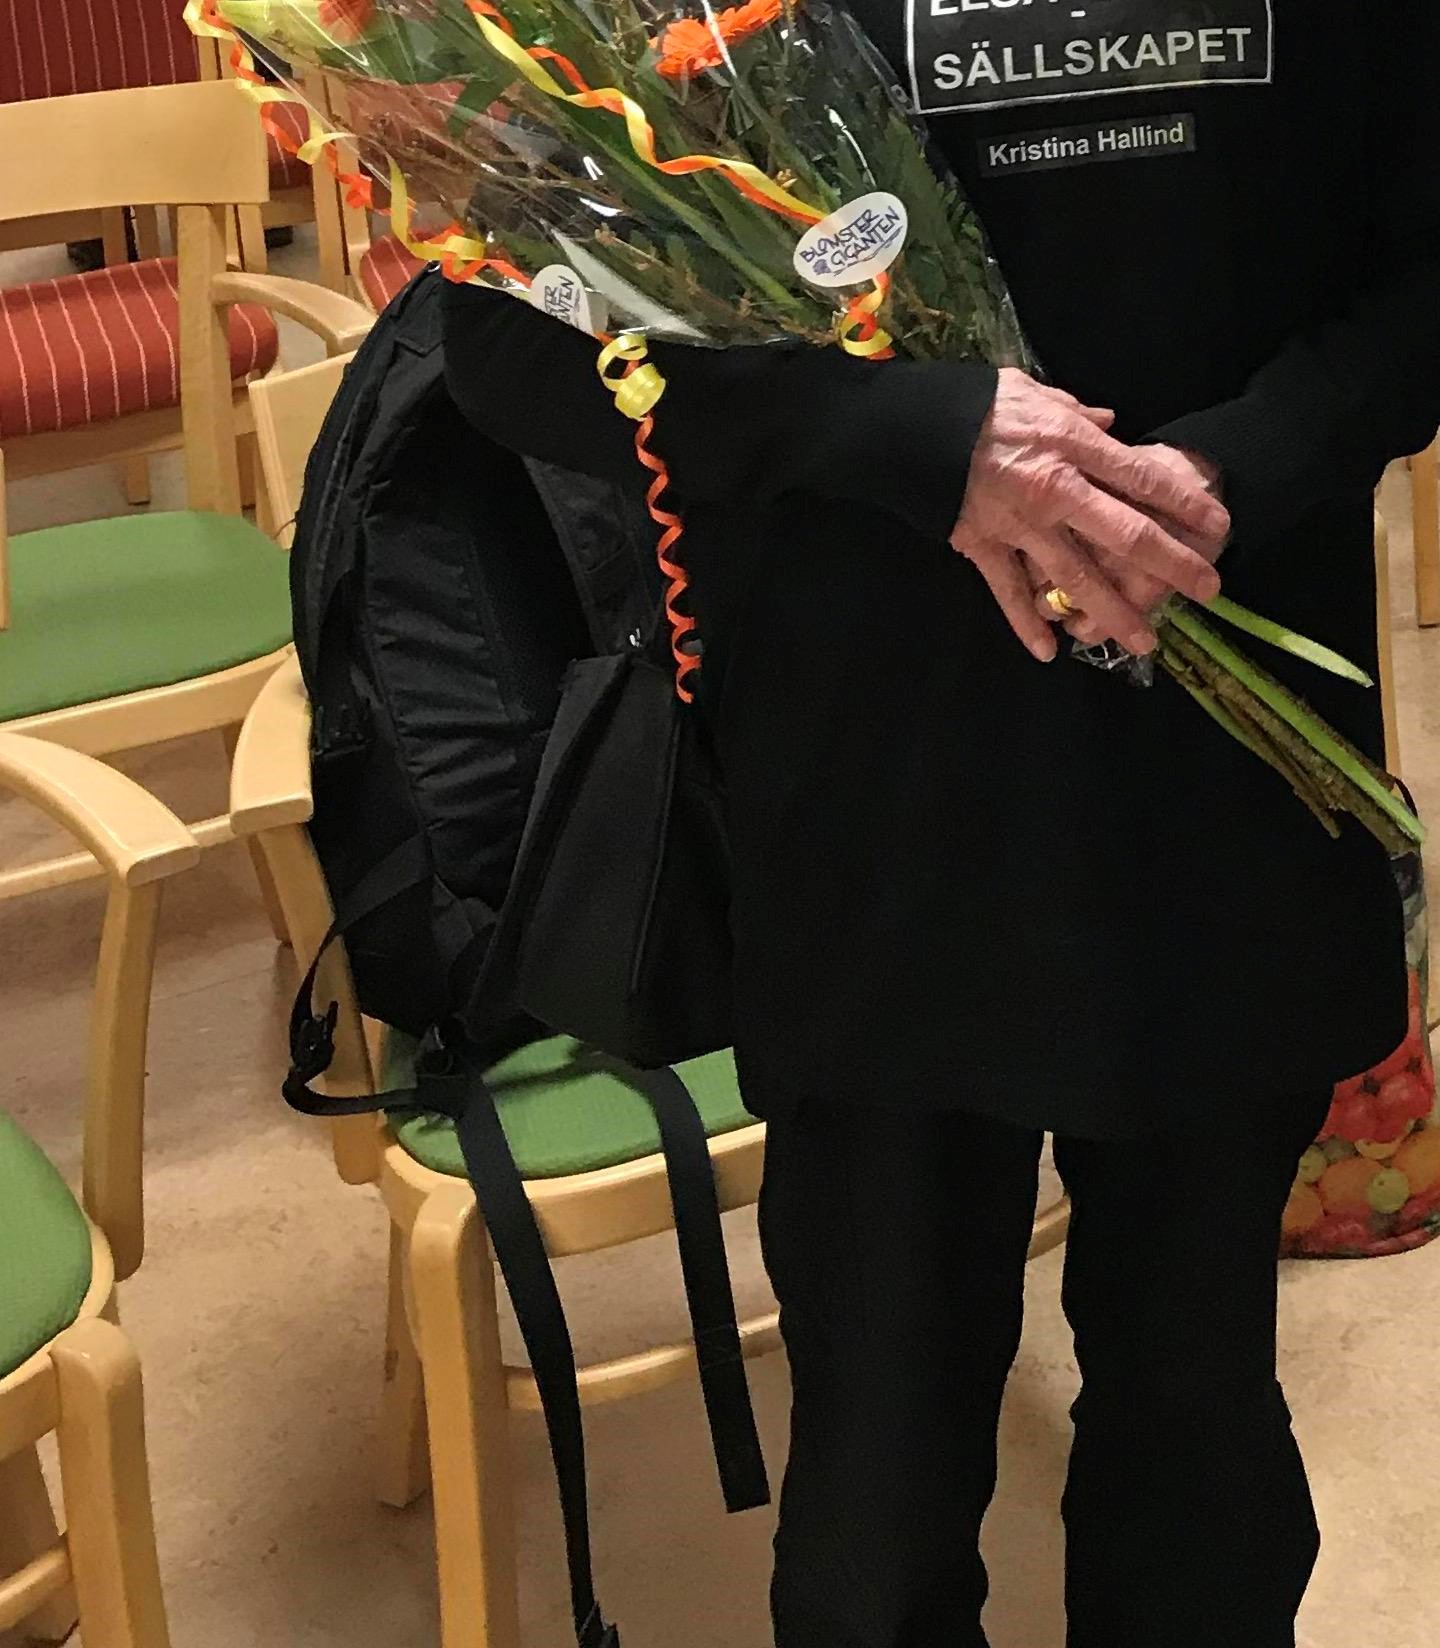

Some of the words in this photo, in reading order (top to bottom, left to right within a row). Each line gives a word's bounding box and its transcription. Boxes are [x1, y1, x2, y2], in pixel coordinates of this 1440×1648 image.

[932, 26, 1252, 90] SÄLLSKAPET
[988, 131, 1091, 168] Kristina
[1096, 121, 1185, 153] Hallind
